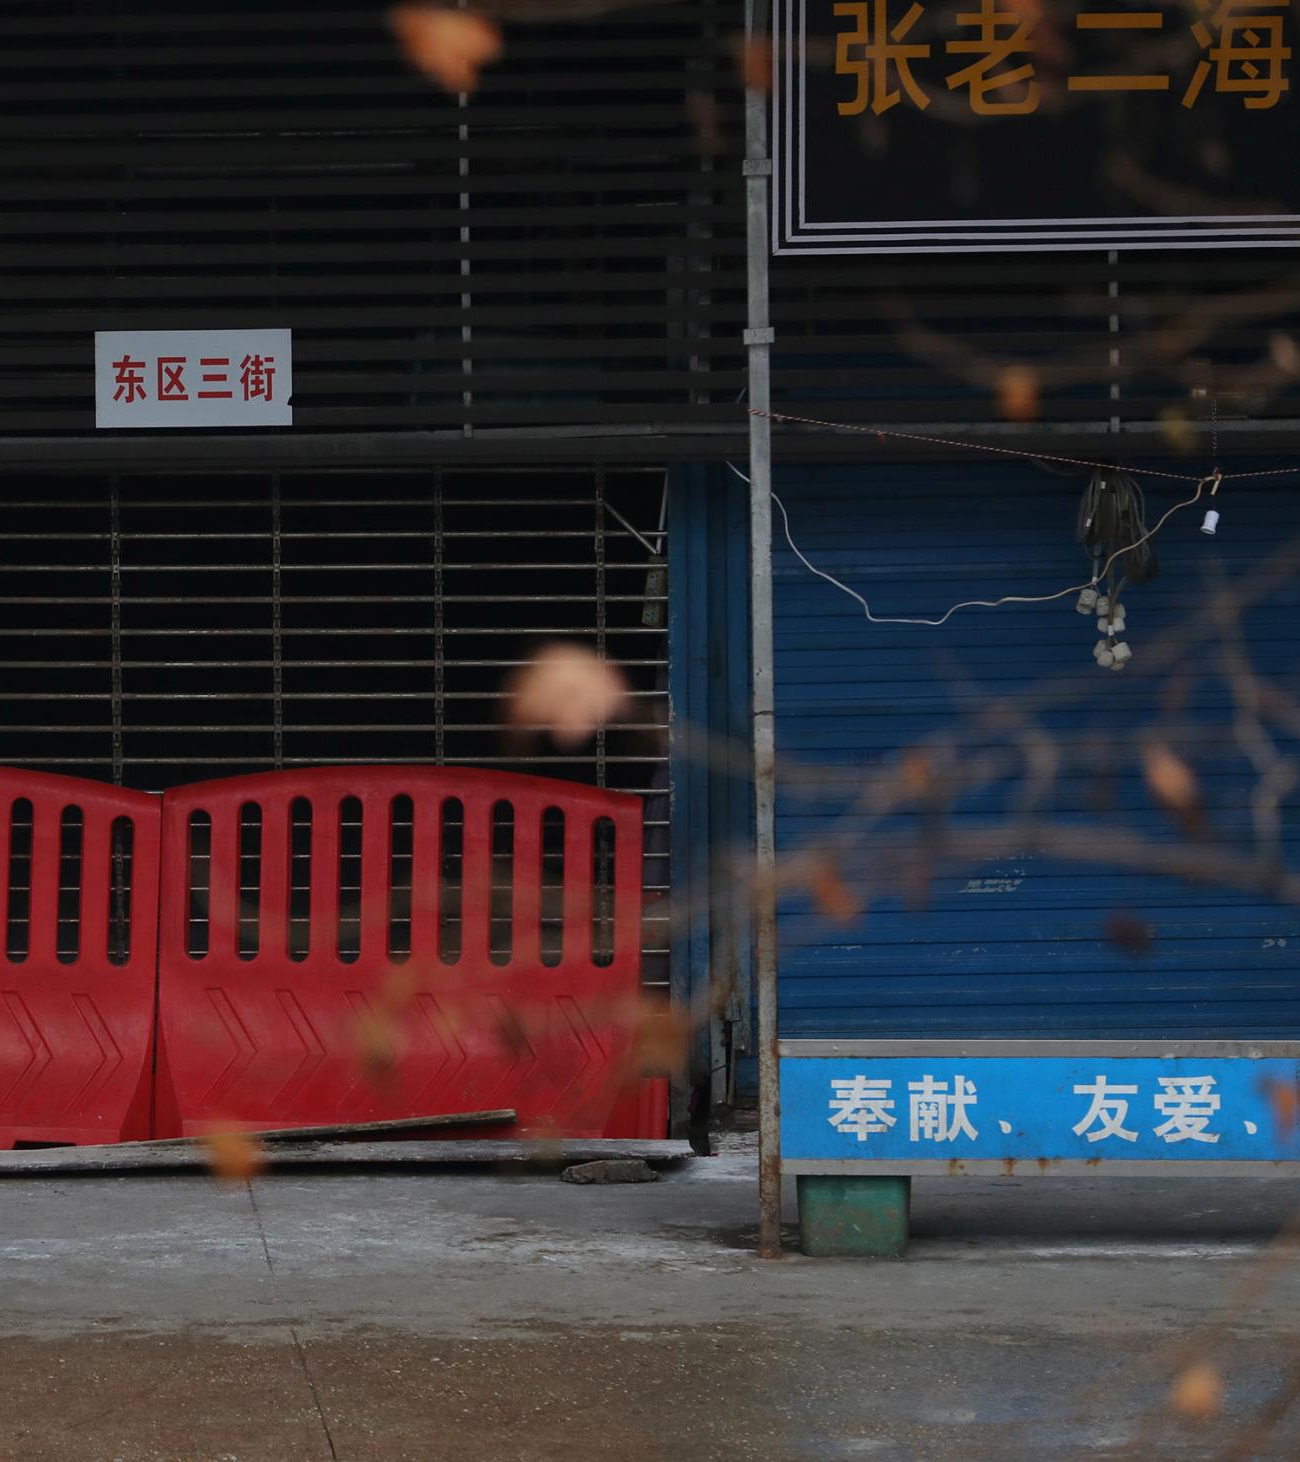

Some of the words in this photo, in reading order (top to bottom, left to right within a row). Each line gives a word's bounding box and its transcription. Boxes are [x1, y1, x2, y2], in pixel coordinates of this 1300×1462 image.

[833, 0, 1292, 115] 张老二海
[112, 354, 276, 403] 东区三街
